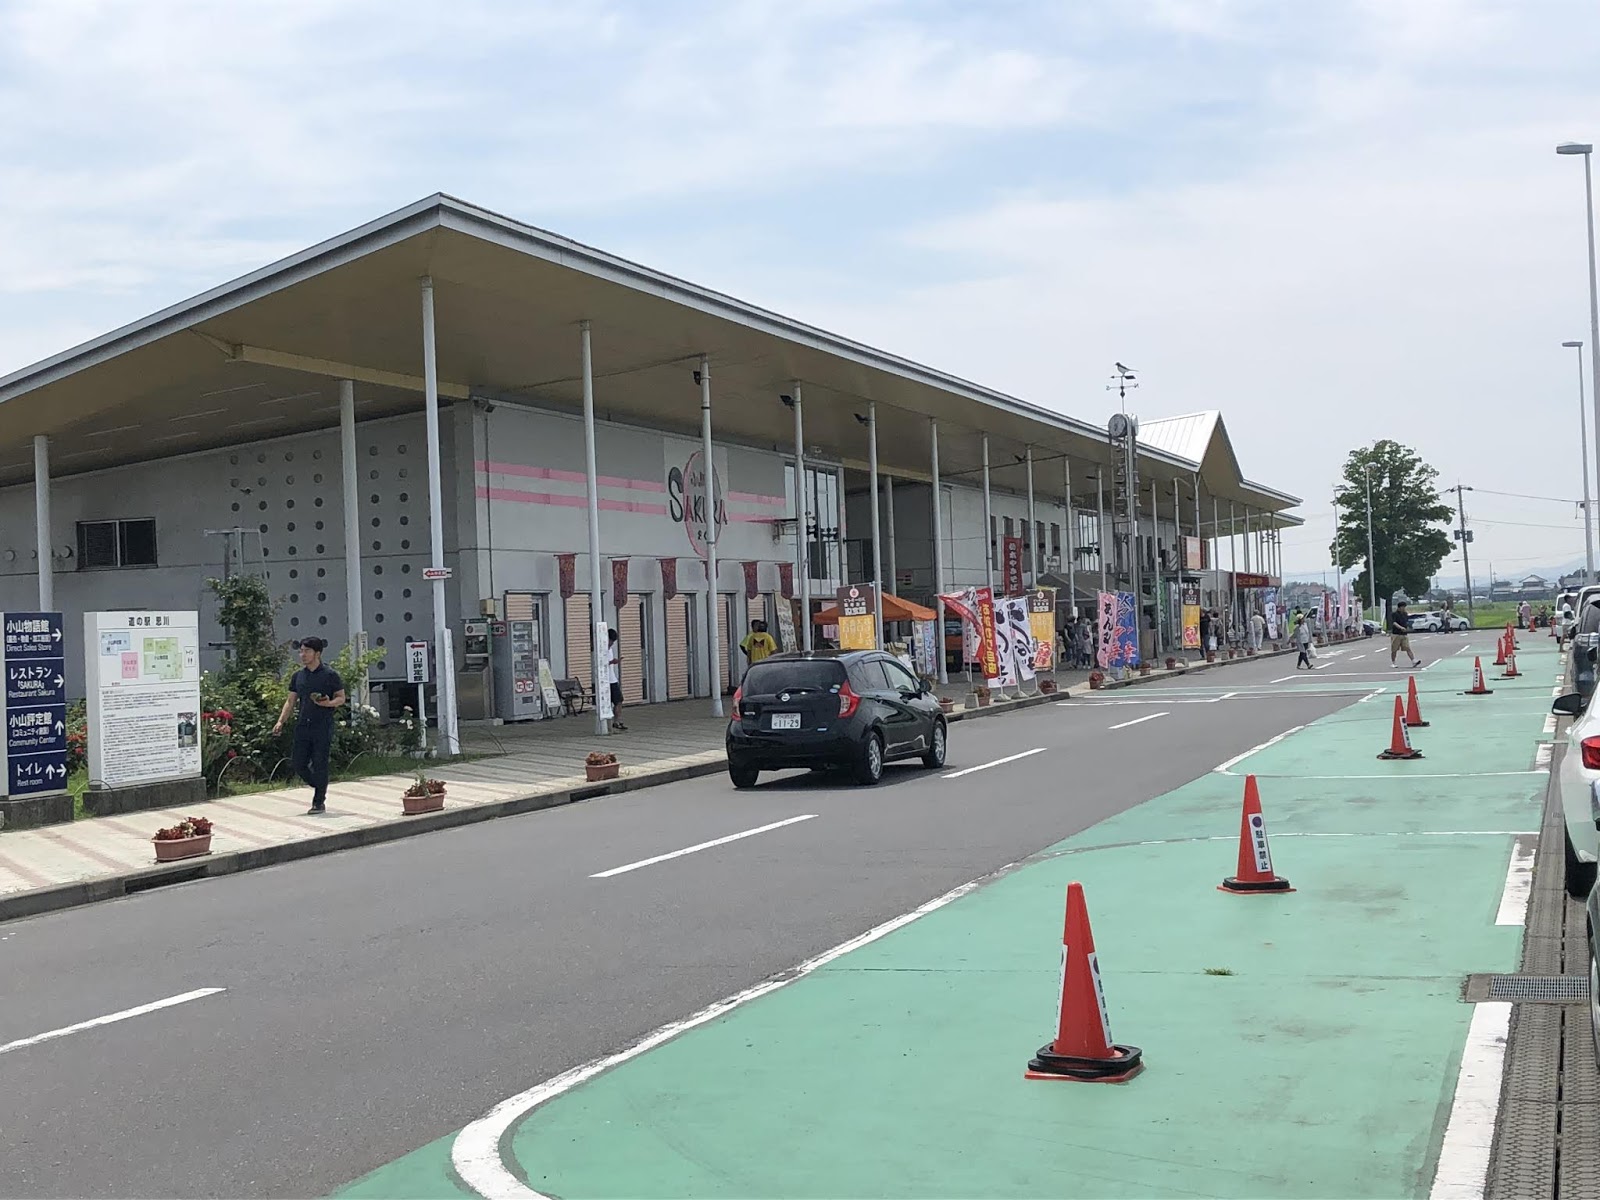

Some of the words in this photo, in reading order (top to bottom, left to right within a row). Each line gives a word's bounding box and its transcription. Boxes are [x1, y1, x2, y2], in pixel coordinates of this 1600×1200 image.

[6, 620, 50, 633] 小山物語館
[128, 616, 151, 626] 道の駅
[6, 644, 23, 652] Direct
[23, 644, 37, 652] Sales
[38, 643, 52, 651] Store
[10, 666, 52, 680] レストラン
[8, 690, 37, 698] Restaurant
[37, 689, 56, 697] Sakura
[9, 711, 53, 728] 小山評定館
[779, 719, 799, 728] 11-29
[8, 738, 39, 747] Community
[38, 736, 57, 744] Center
[17, 762, 43, 777] トイレ
[17, 779, 29, 787] Rest
[29, 778, 43, 786] room
[1255, 829, 1269, 870] 駐車禁止
